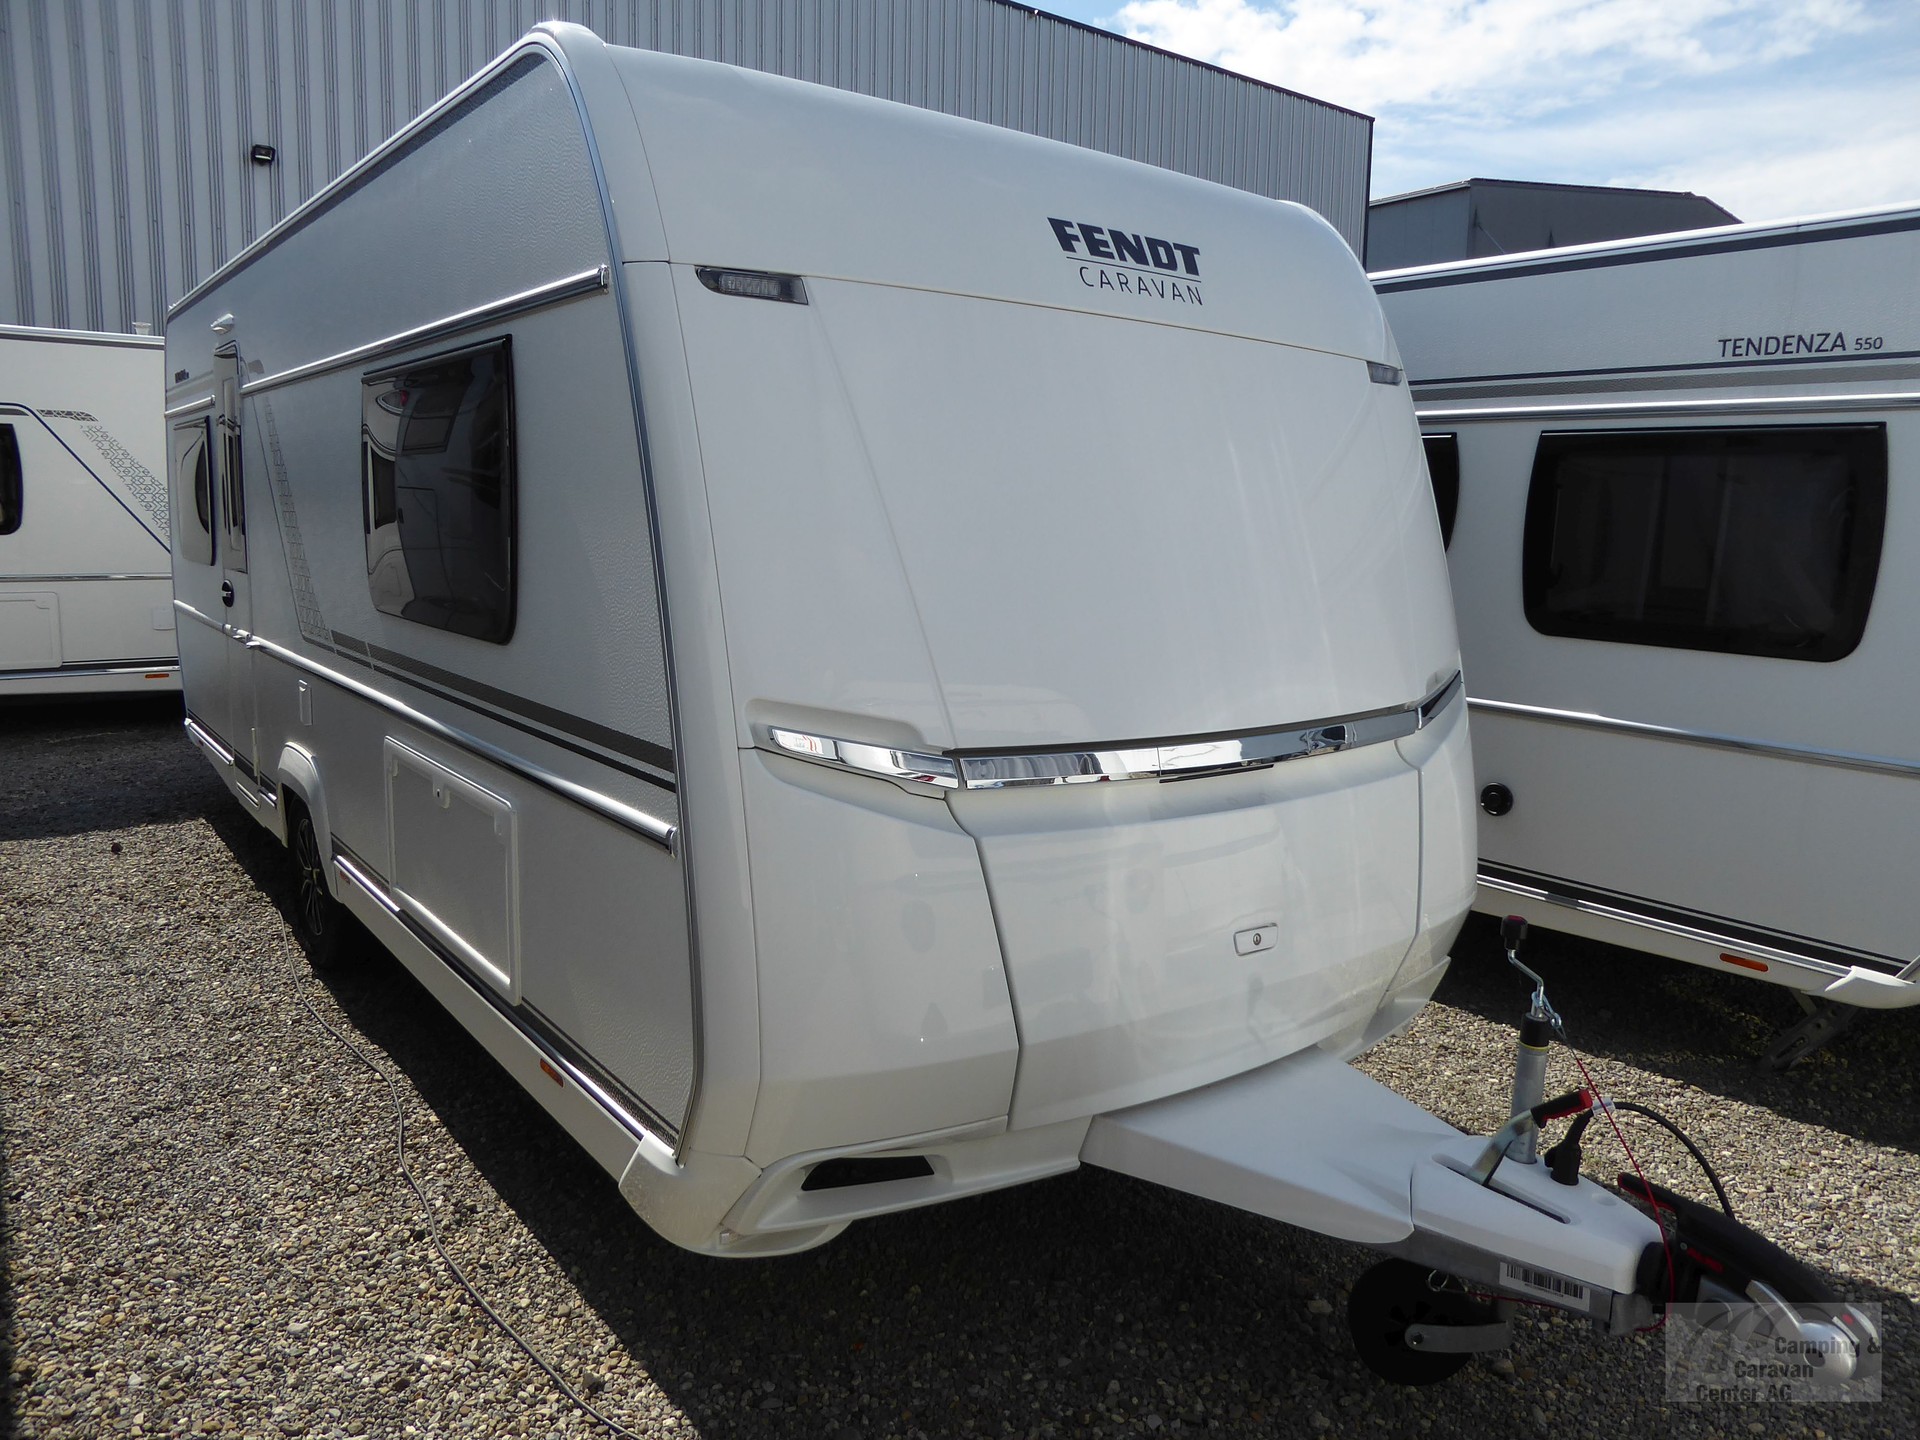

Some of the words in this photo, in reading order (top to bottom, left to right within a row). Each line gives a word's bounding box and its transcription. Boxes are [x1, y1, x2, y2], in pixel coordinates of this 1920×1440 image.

[1047, 217, 1200, 276] FENDT
[1079, 266, 1203, 306] CARAVAN
[1718, 331, 1847, 358] TENDENZA
[1854, 337, 1883, 351] 550
